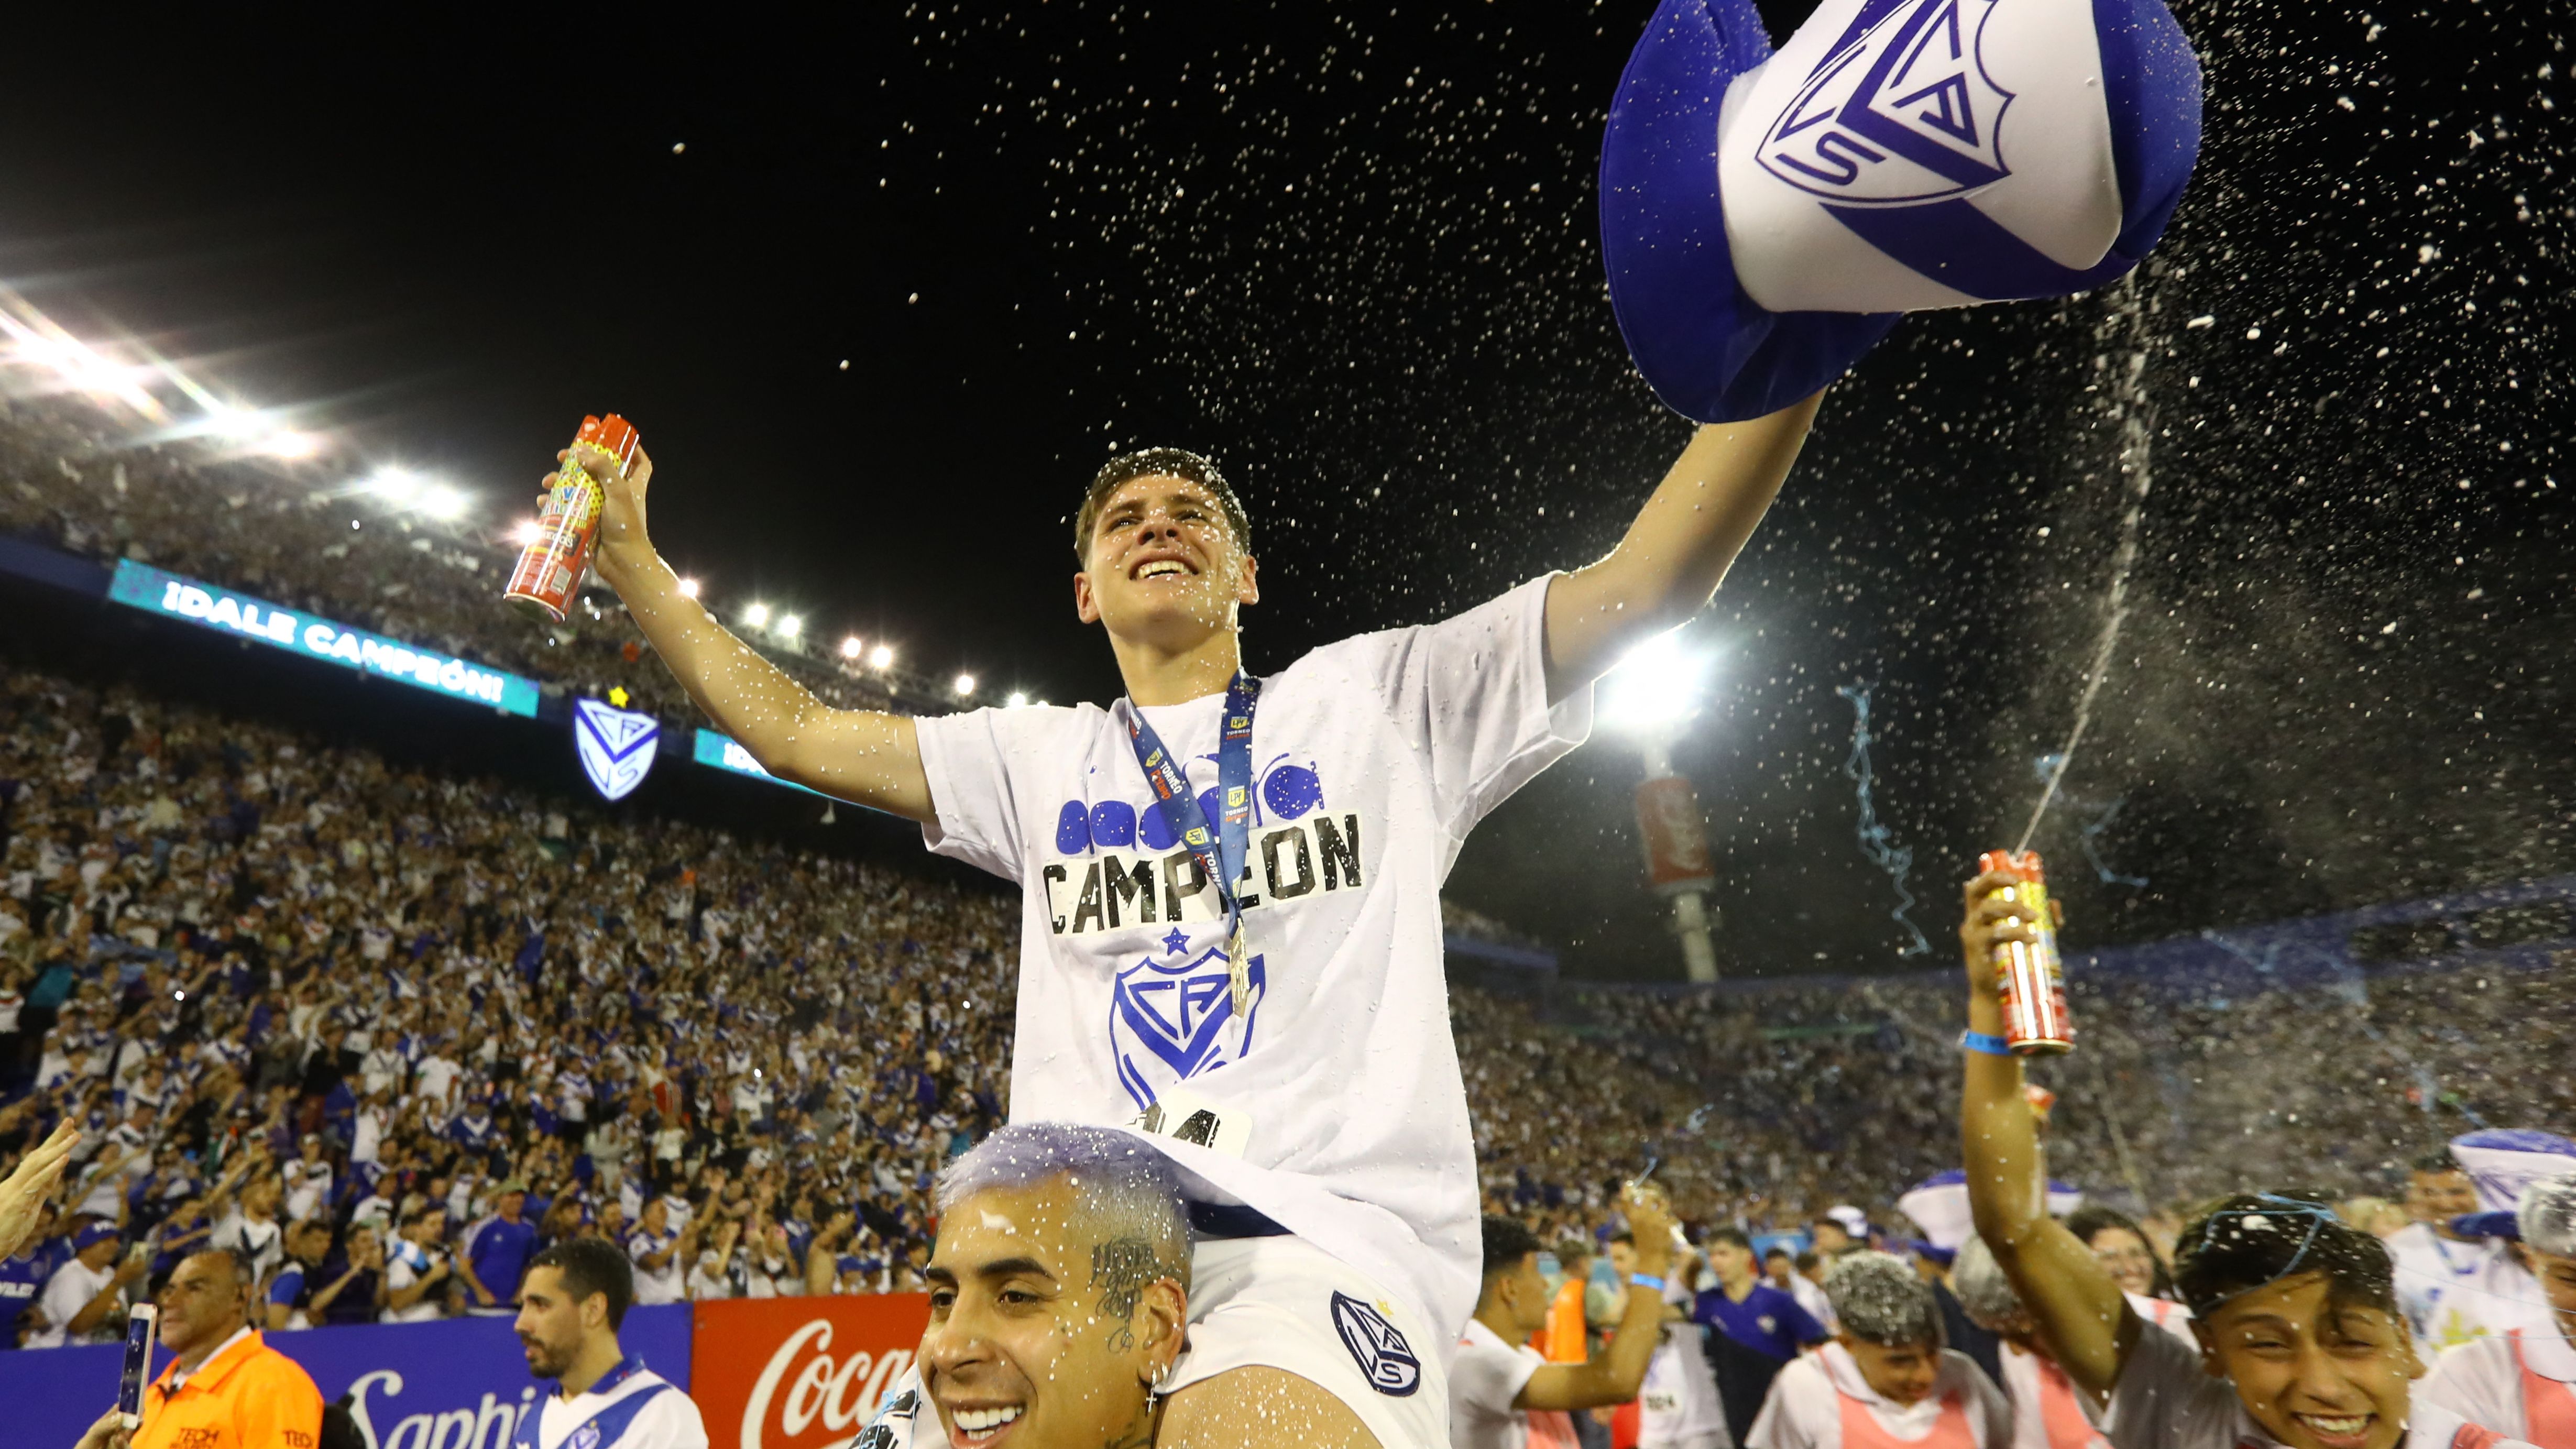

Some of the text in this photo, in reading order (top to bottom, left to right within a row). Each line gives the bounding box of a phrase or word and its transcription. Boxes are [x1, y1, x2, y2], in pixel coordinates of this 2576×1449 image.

[303, 624, 505, 703] CAMPEÓN!
[1160, 761, 1183, 794] TORNEO
[1225, 806, 1248, 816] TORNEO
[740, 1318, 914, 1449] Coca
